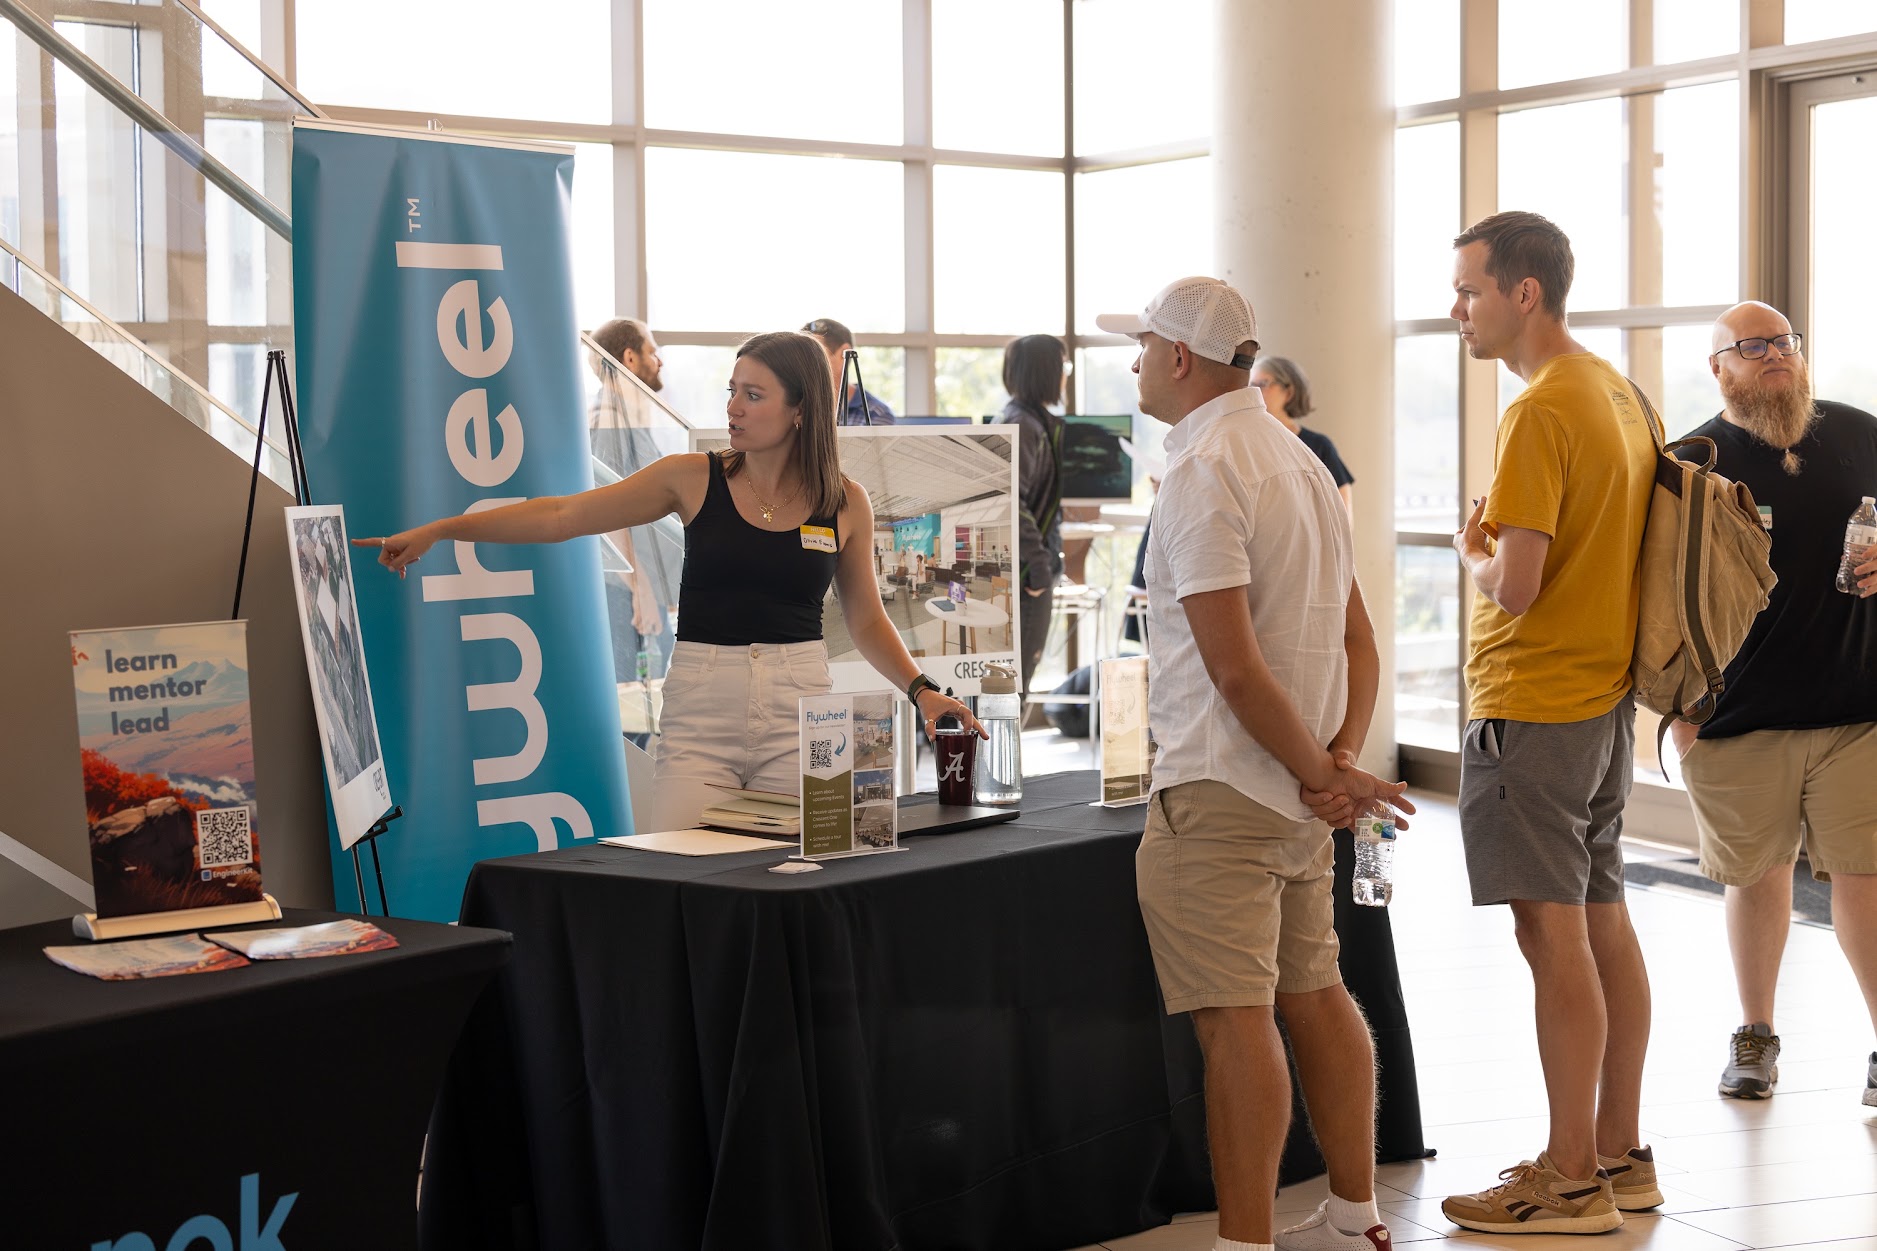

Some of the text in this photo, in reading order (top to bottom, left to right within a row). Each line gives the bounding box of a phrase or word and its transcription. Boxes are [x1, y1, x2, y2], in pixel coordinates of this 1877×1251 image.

[396, 241, 594, 853] ywheel
[105, 649, 177, 673] learn
[109, 677, 207, 702] mentor
[111, 707, 169, 735] lead
[806, 708, 847, 725] Flywheel
[938, 751, 966, 783] A
[212, 866, 253, 880] EngineerKit
[1533, 1191, 1560, 1206] Reebok
